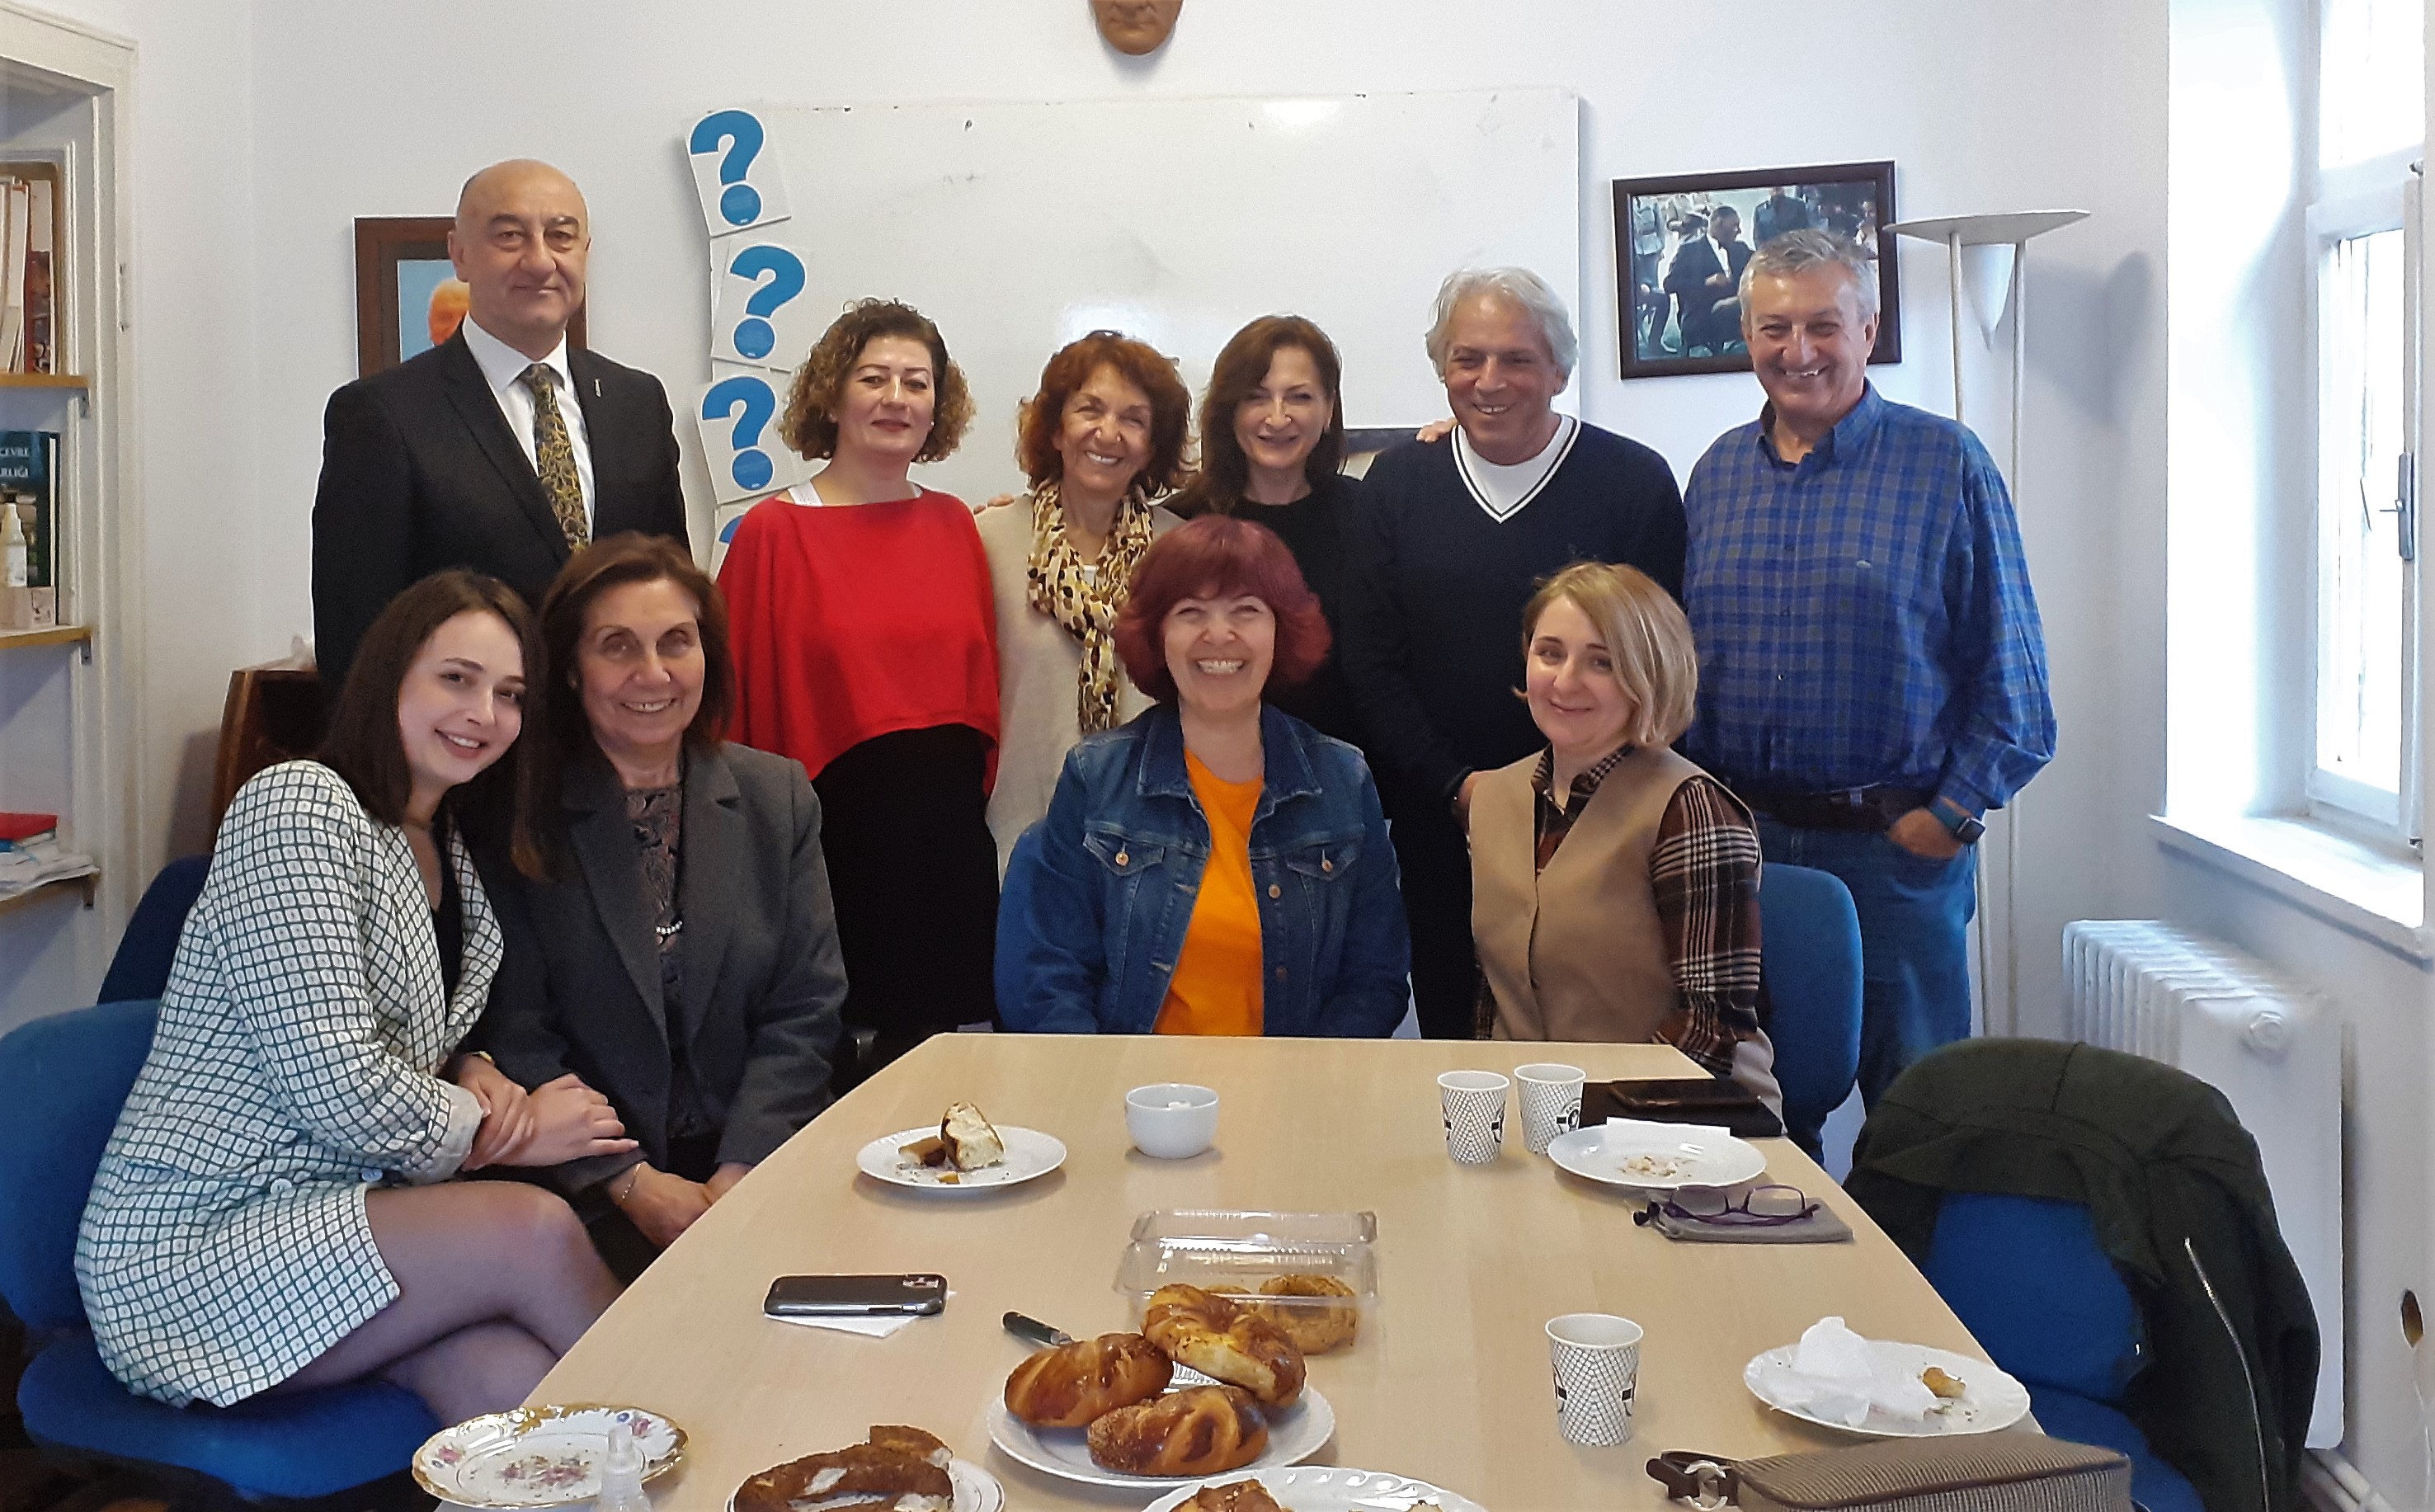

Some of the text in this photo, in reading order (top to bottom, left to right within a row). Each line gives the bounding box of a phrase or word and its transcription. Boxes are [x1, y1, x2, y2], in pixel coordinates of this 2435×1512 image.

[690, 109, 765, 226] ?
[730, 243, 806, 360] ?
[701, 376, 776, 492] ?
